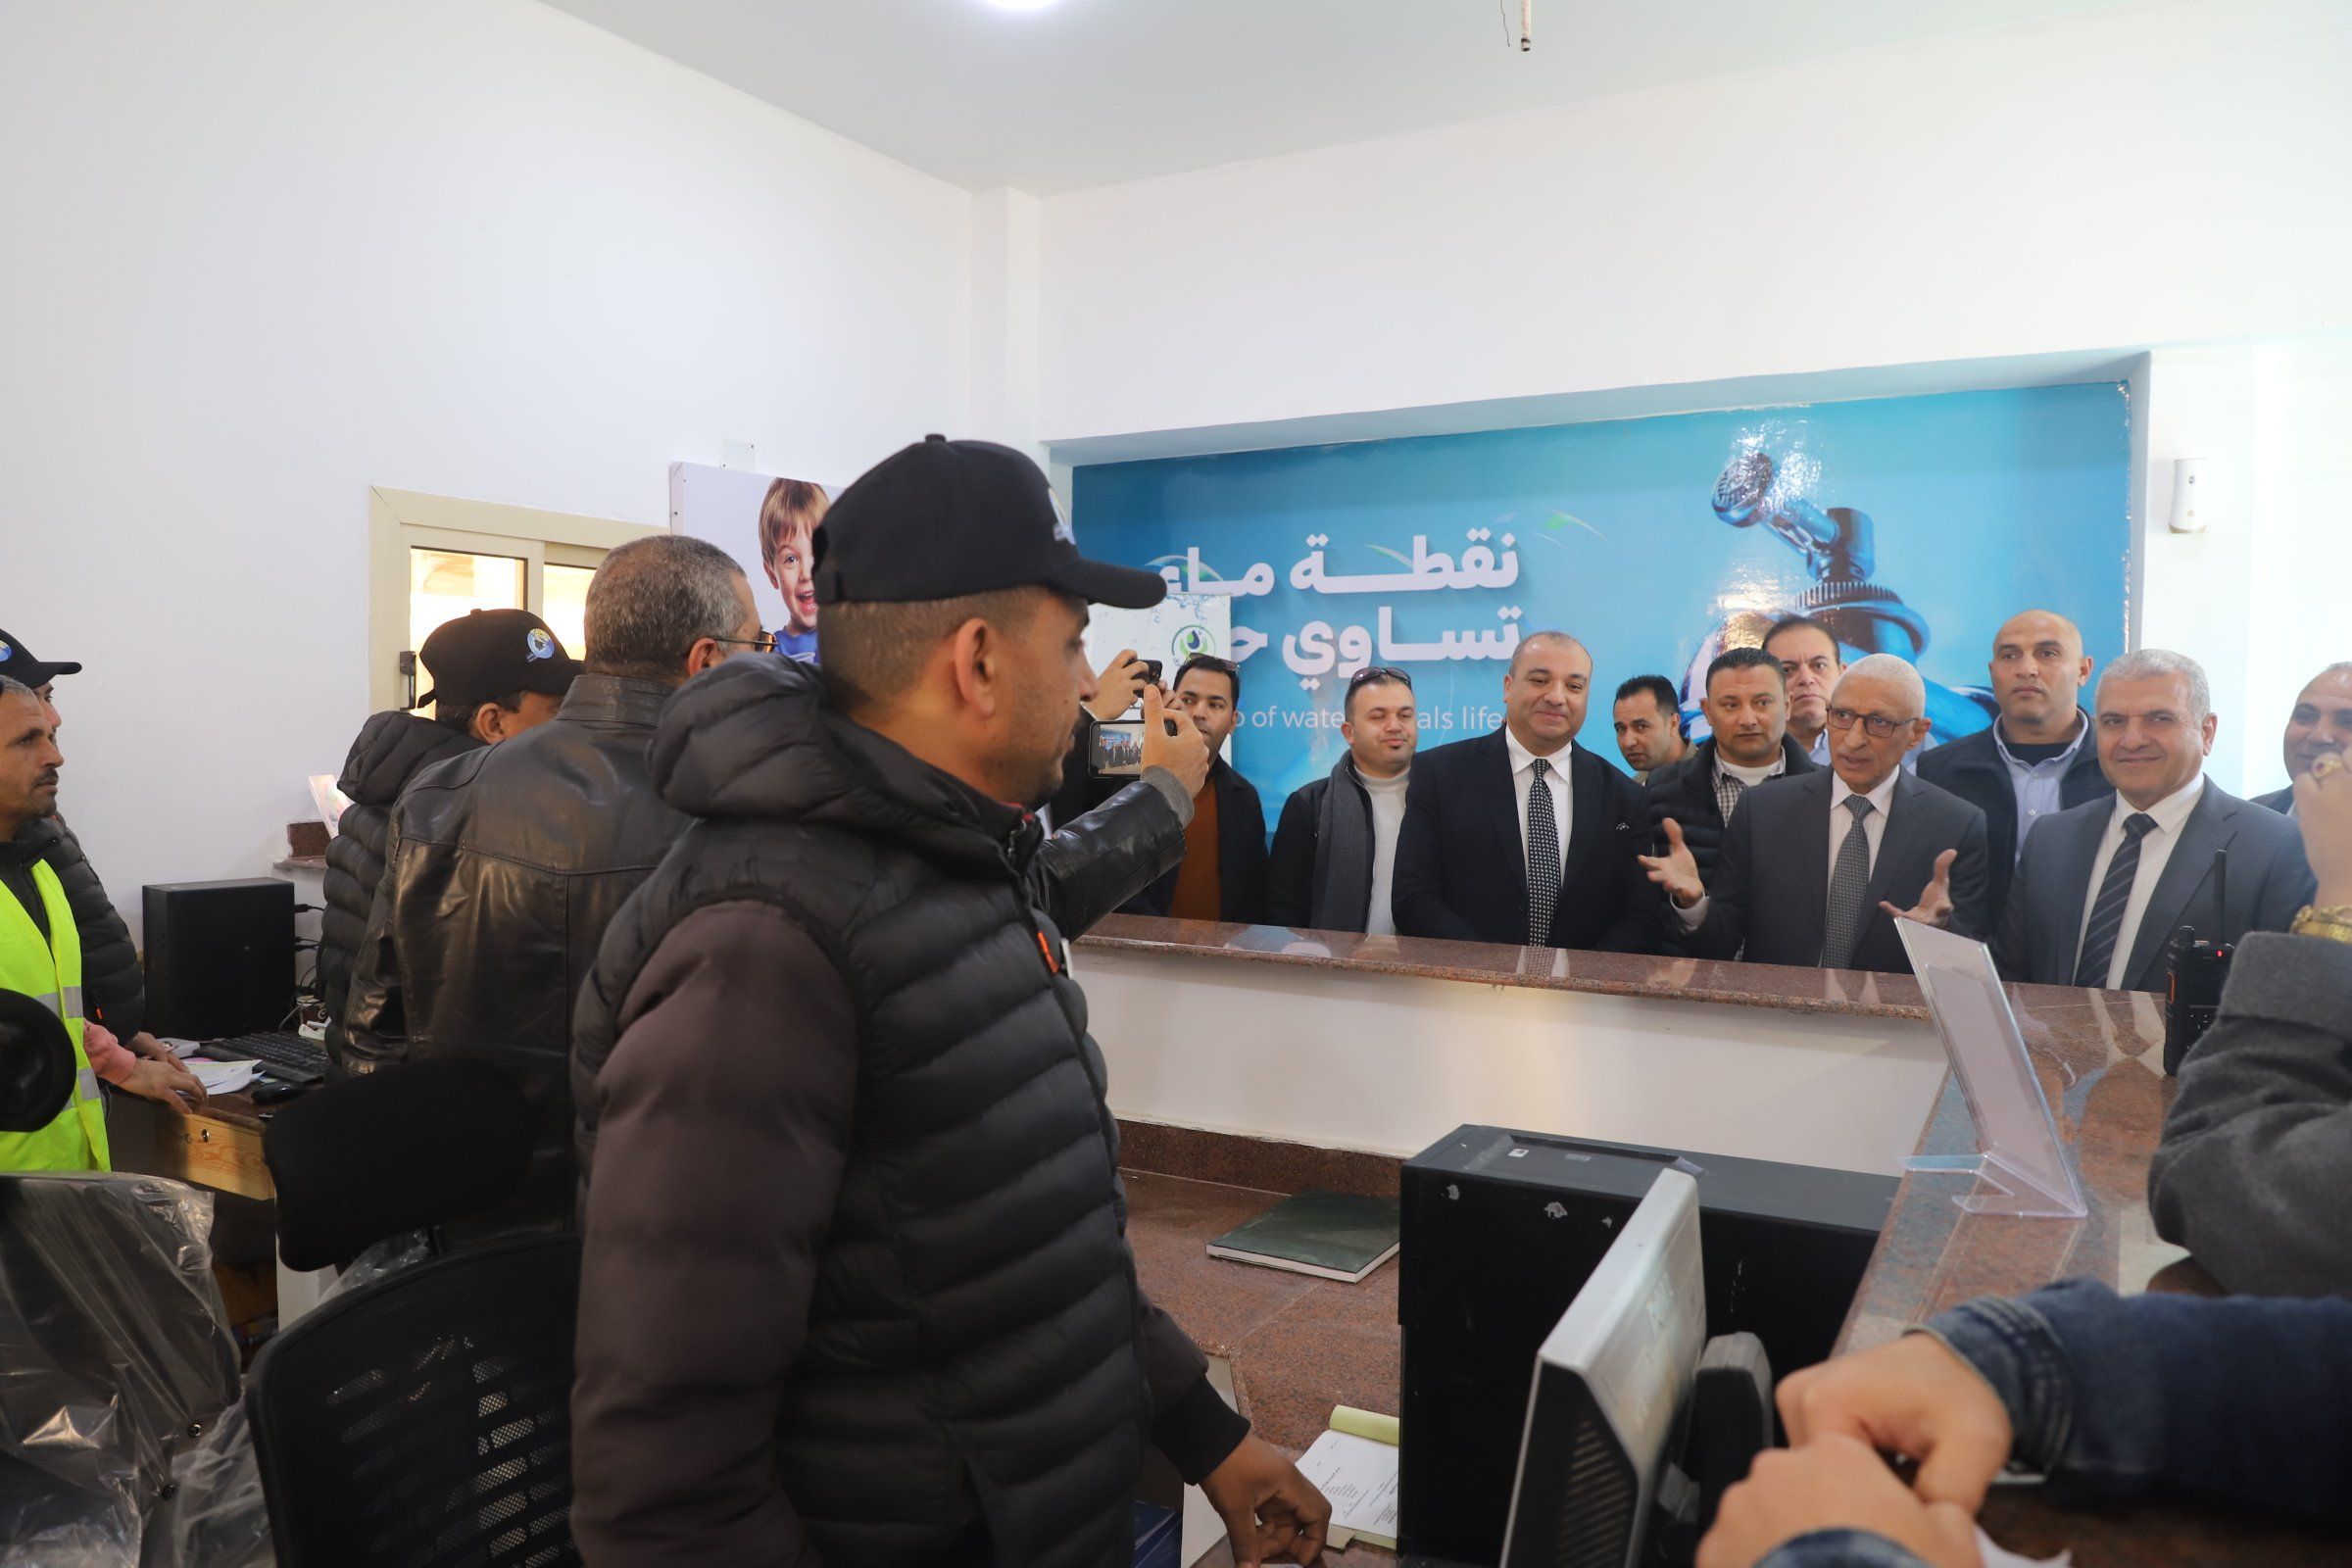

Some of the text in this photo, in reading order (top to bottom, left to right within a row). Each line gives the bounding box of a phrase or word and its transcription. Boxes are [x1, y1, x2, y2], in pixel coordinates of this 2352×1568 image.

[1290, 527, 1519, 594] نقطة
[1282, 606, 1523, 691] تساوي
[1251, 705, 1277, 728] of
[1282, 709, 1346, 729] wate
[1417, 705, 1454, 730] als
[1462, 705, 1503, 730] life
